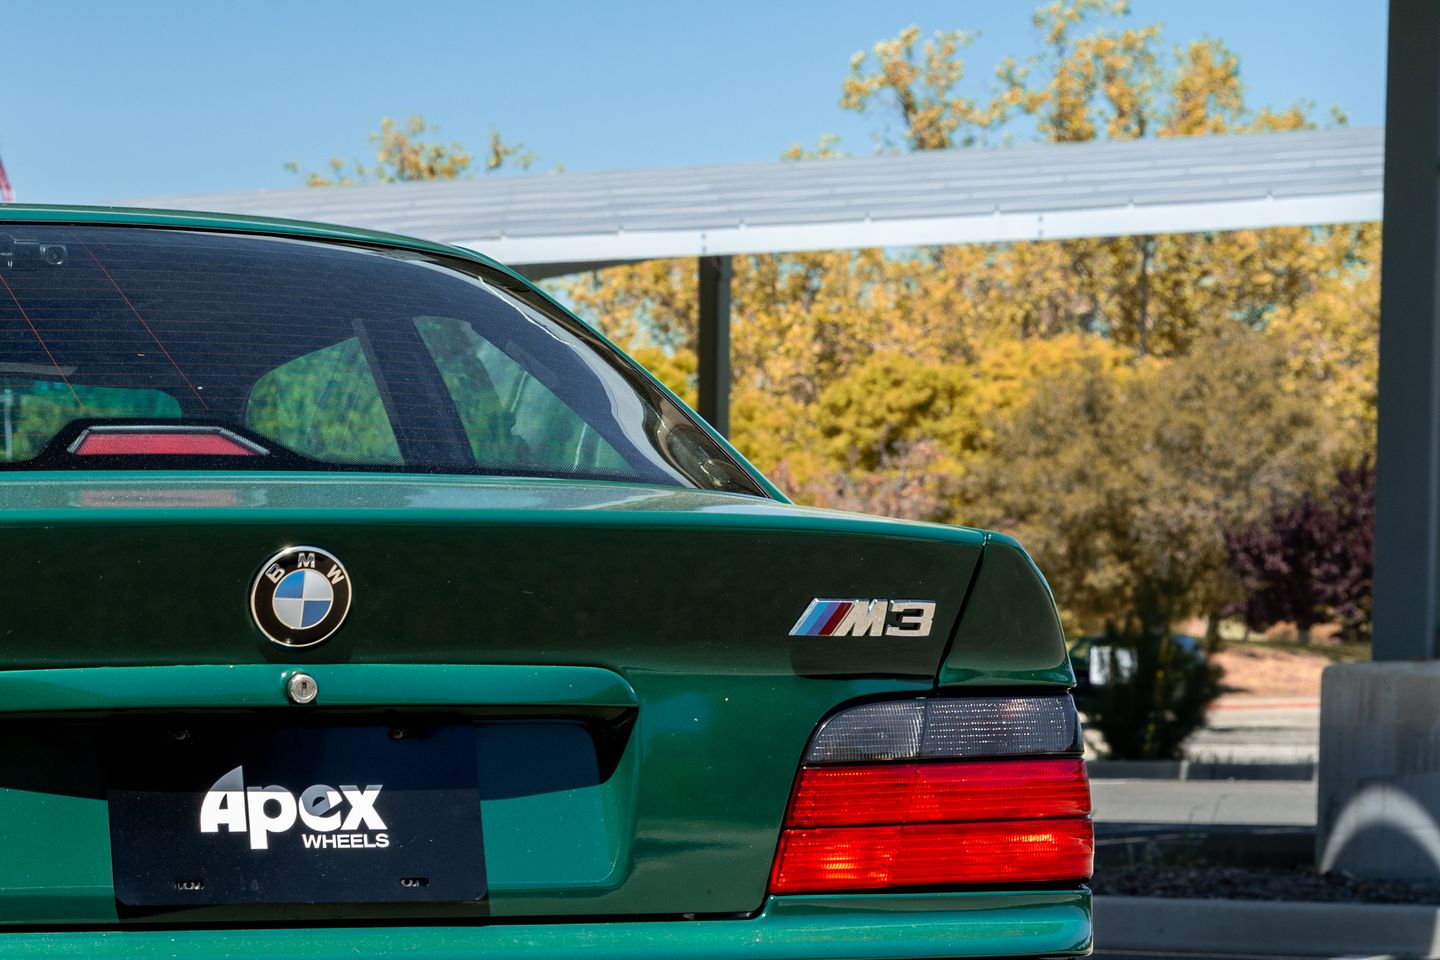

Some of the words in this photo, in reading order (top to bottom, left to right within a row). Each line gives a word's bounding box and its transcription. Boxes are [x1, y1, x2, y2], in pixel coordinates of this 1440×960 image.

[265, 552, 345, 584] BMW
[827, 598, 937, 637] M3
[201, 765, 387, 850] Apex
[302, 833, 390, 849] WHEELS
